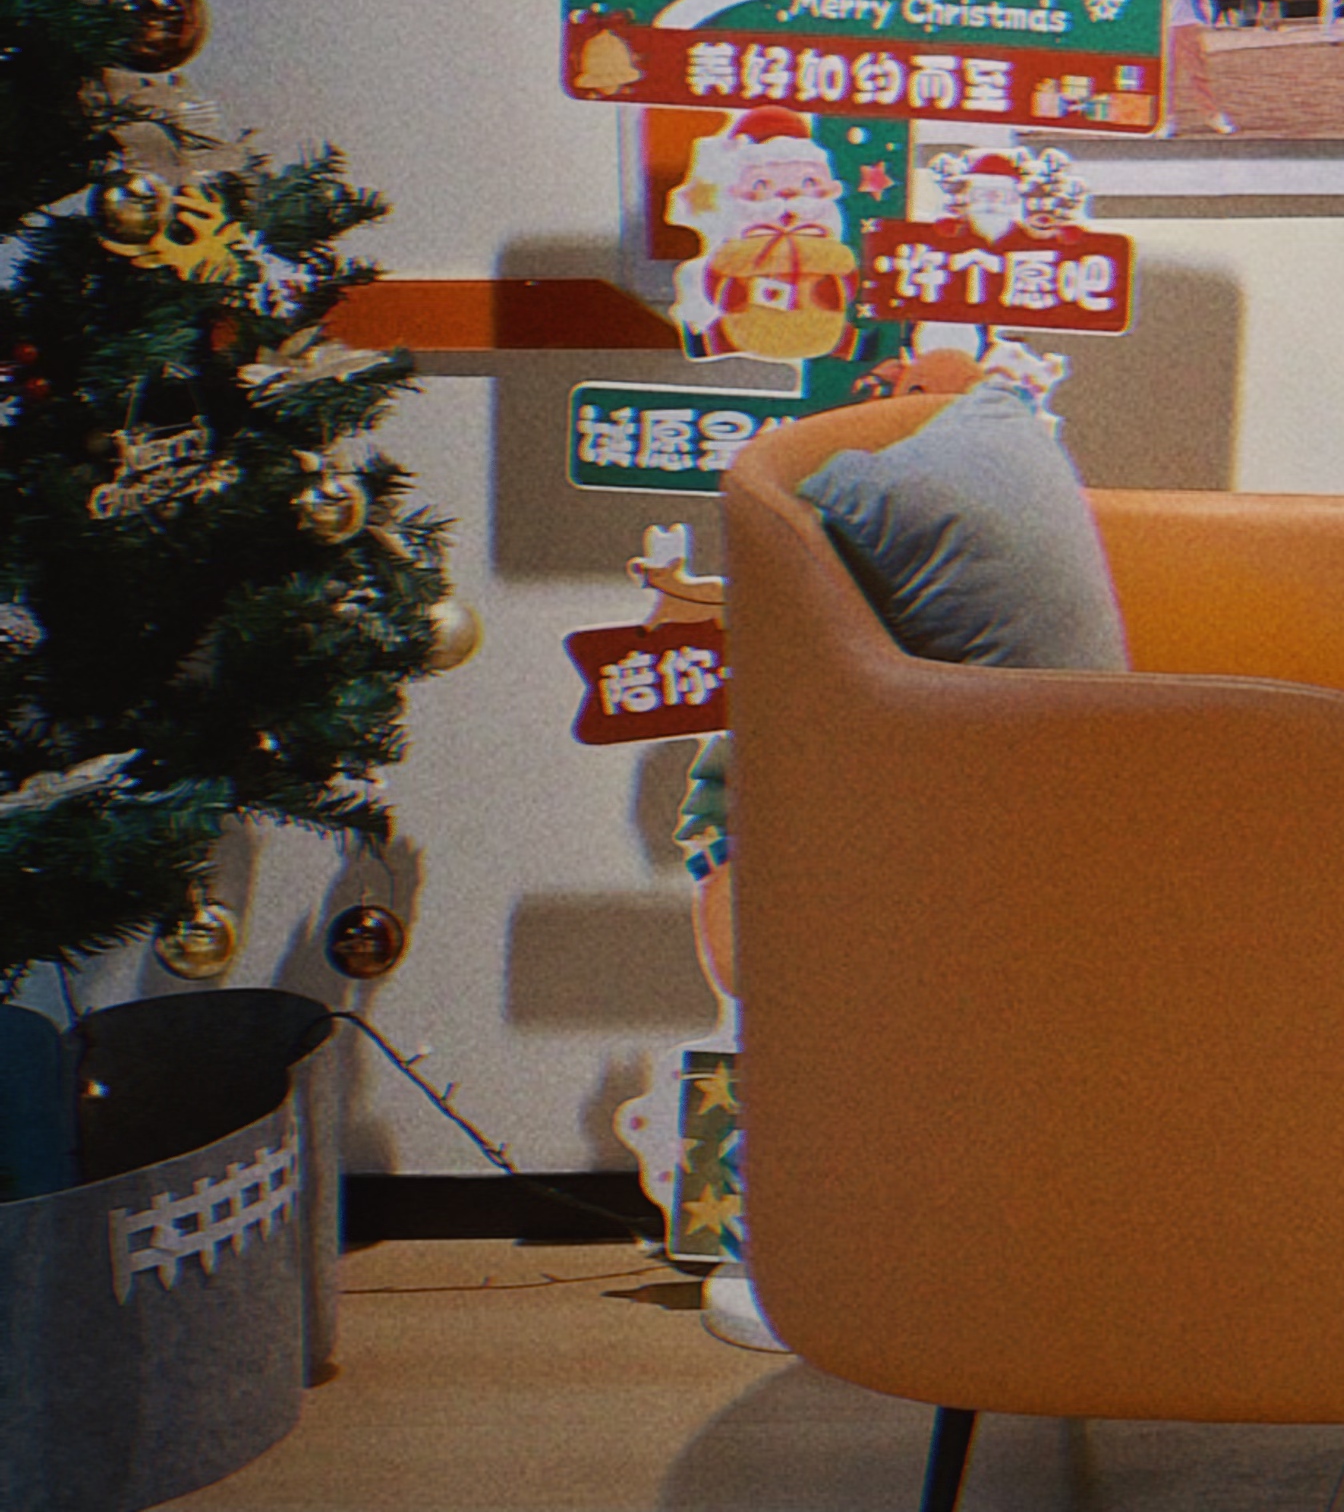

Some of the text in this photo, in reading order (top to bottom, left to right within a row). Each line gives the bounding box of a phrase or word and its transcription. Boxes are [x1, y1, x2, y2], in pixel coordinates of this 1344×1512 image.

[686, 42, 1014, 113] 美好如约而至
[894, 243, 1116, 312] 许个愿吧
[598, 645, 732, 716] 陪你
